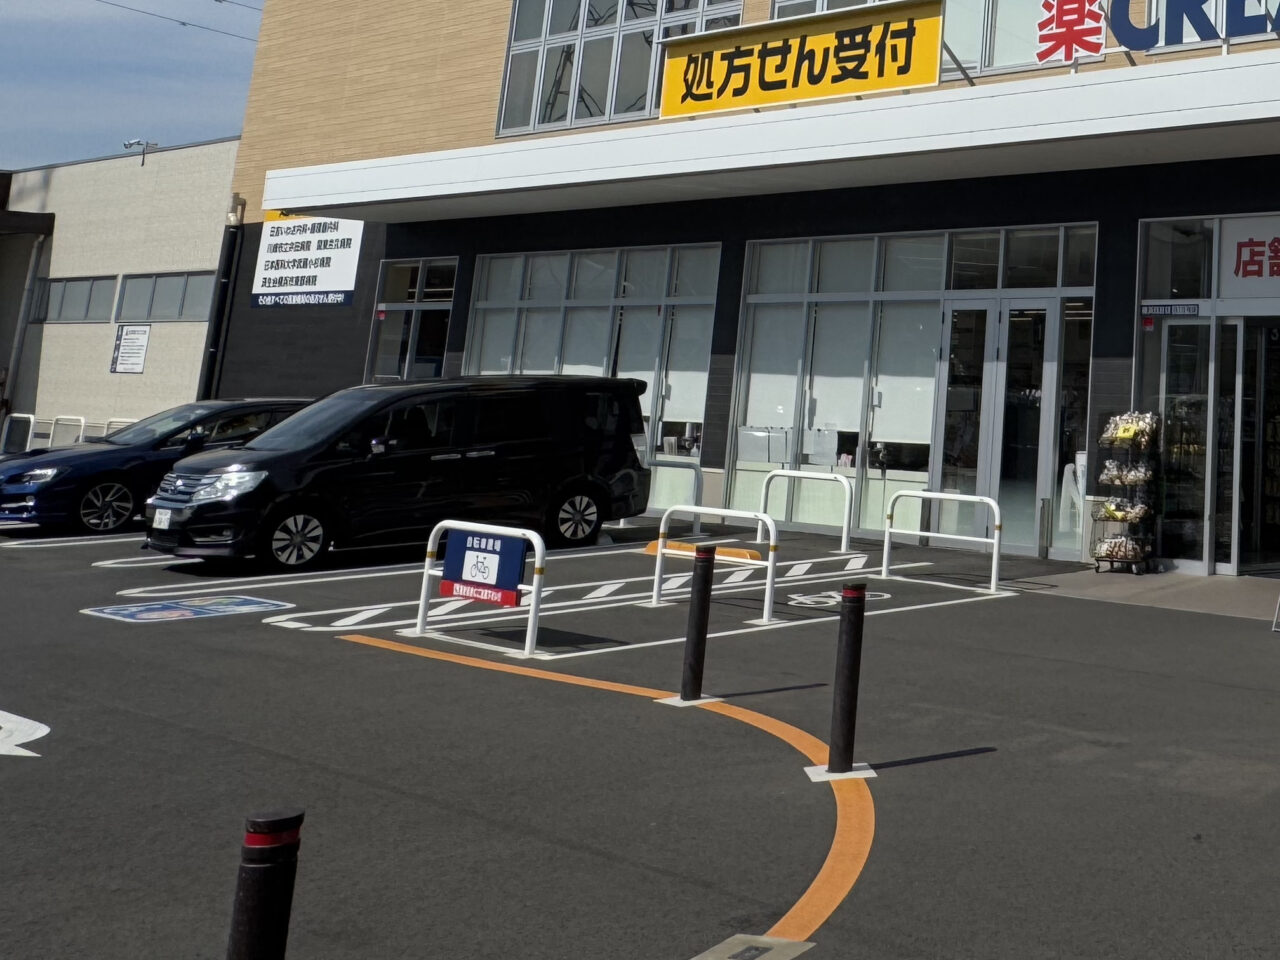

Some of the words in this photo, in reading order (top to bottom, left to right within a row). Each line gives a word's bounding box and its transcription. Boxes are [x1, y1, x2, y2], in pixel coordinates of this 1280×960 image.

[681, 18, 917, 104] 処方せん受付
